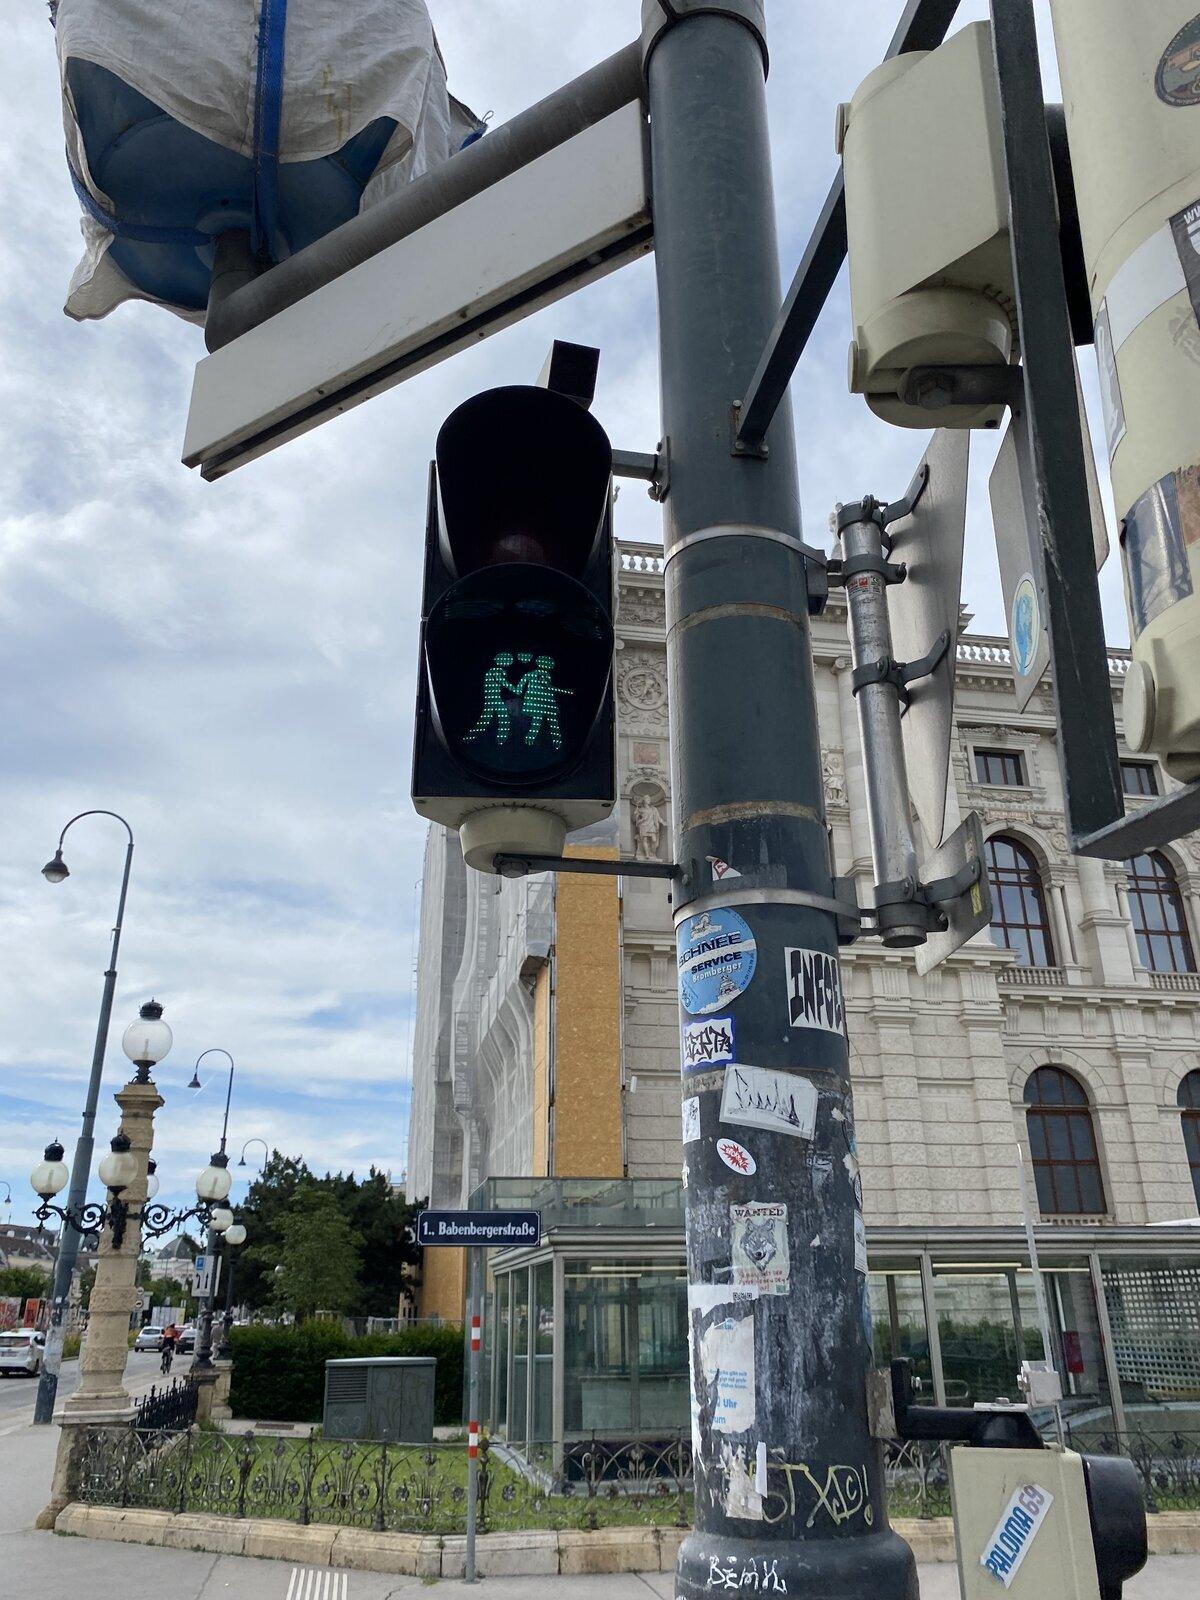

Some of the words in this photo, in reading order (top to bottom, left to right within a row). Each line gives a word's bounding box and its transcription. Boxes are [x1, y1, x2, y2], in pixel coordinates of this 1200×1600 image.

[679, 930, 742, 968] SCHNEE
[691, 951, 743, 975] SERVICE
[692, 962, 743, 984] Bromberger
[734, 1208, 785, 1218] WANTED
[438, 1221, 536, 1239] Babenbergerstraße
[723, 1398, 737, 1409] Uhr
[985, 1506, 1035, 1582] PALOMA
[1018, 1484, 1045, 1516] 69
